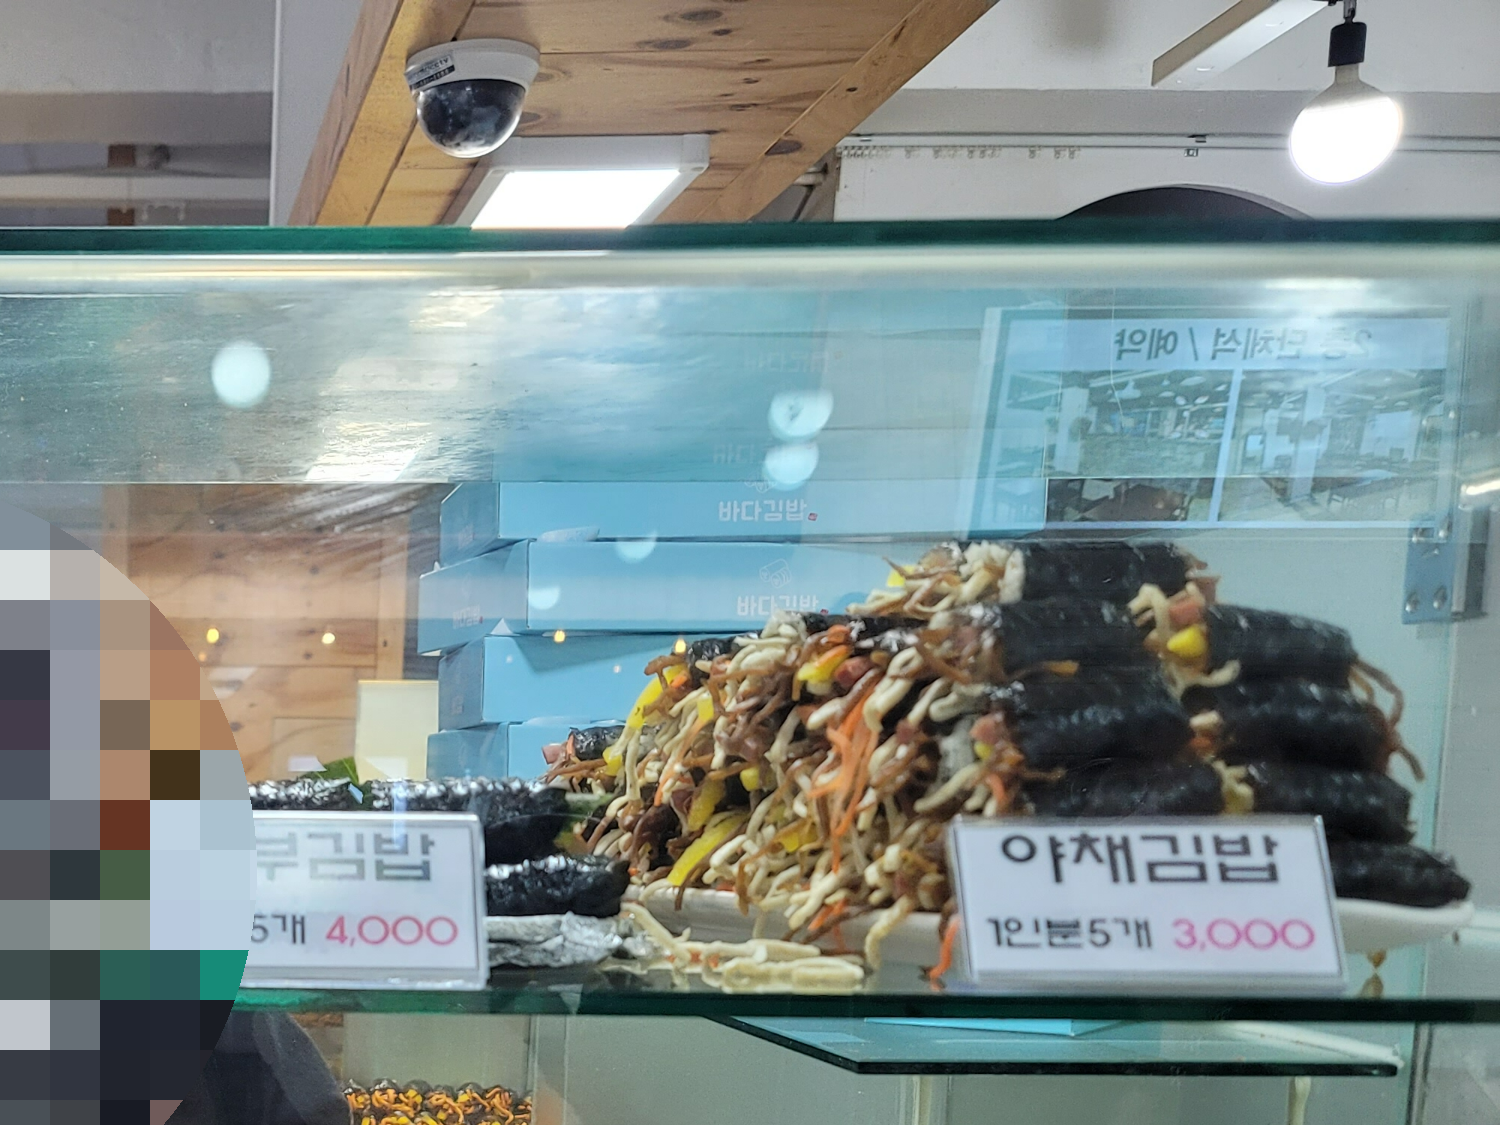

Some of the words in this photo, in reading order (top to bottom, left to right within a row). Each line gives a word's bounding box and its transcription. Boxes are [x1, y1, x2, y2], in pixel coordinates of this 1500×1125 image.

[717, 498, 808, 523] 바다김밥
[1001, 833, 1280, 885] 야채김밥
[324, 914, 460, 947] 4,000
[1172, 918, 1316, 951] 3,000
